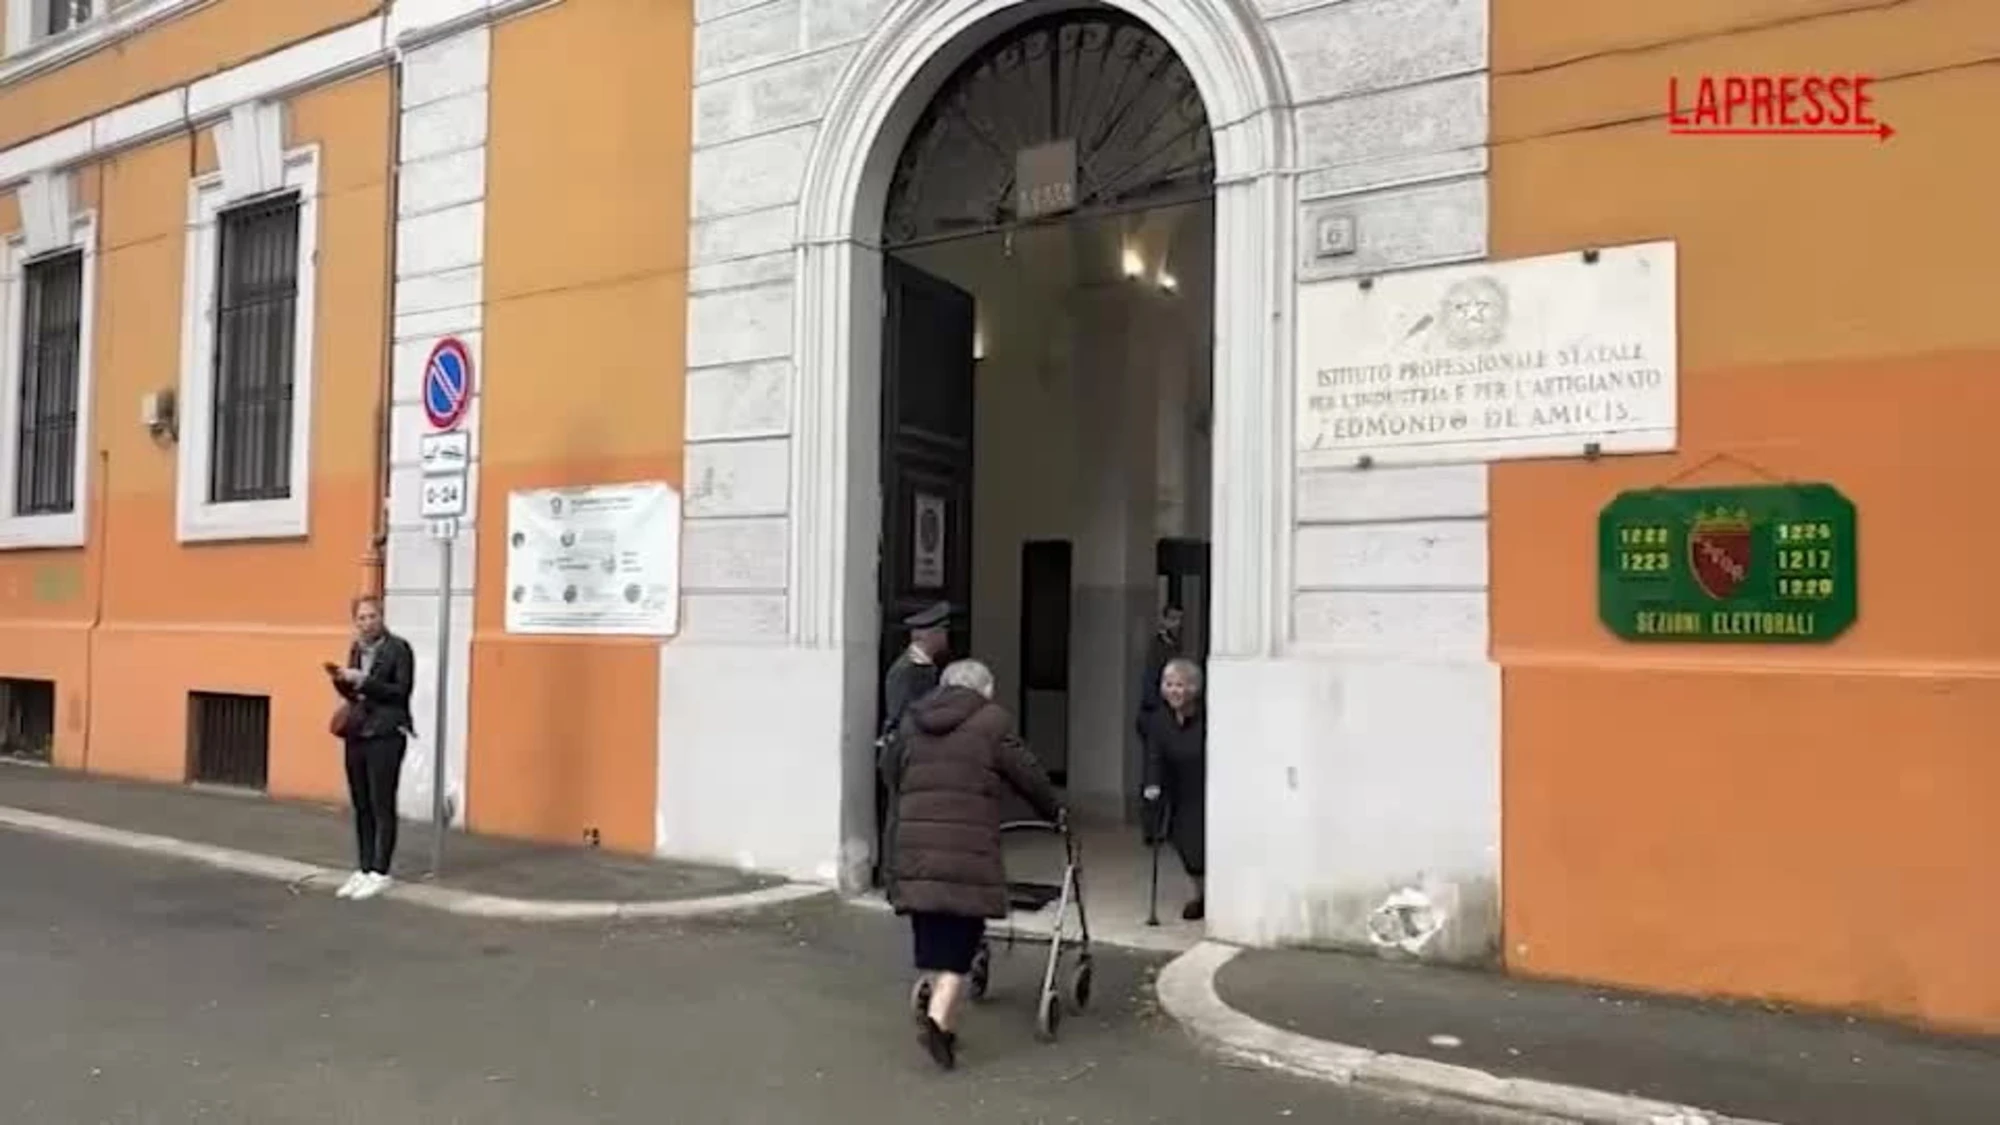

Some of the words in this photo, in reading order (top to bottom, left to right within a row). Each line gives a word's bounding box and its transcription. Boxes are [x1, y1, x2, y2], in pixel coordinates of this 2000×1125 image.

[1317, 363, 1392, 387] ISTITUTO
[1455, 383, 1465, 401] E
[1474, 381, 1506, 402] PER
[1484, 407, 1516, 429] DE
[1621, 551, 1670, 571] 1223
[1778, 549, 1831, 569] 1217
[1636, 611, 1700, 634] SEZIONI
[1712, 611, 1815, 635] ELETTORALI
